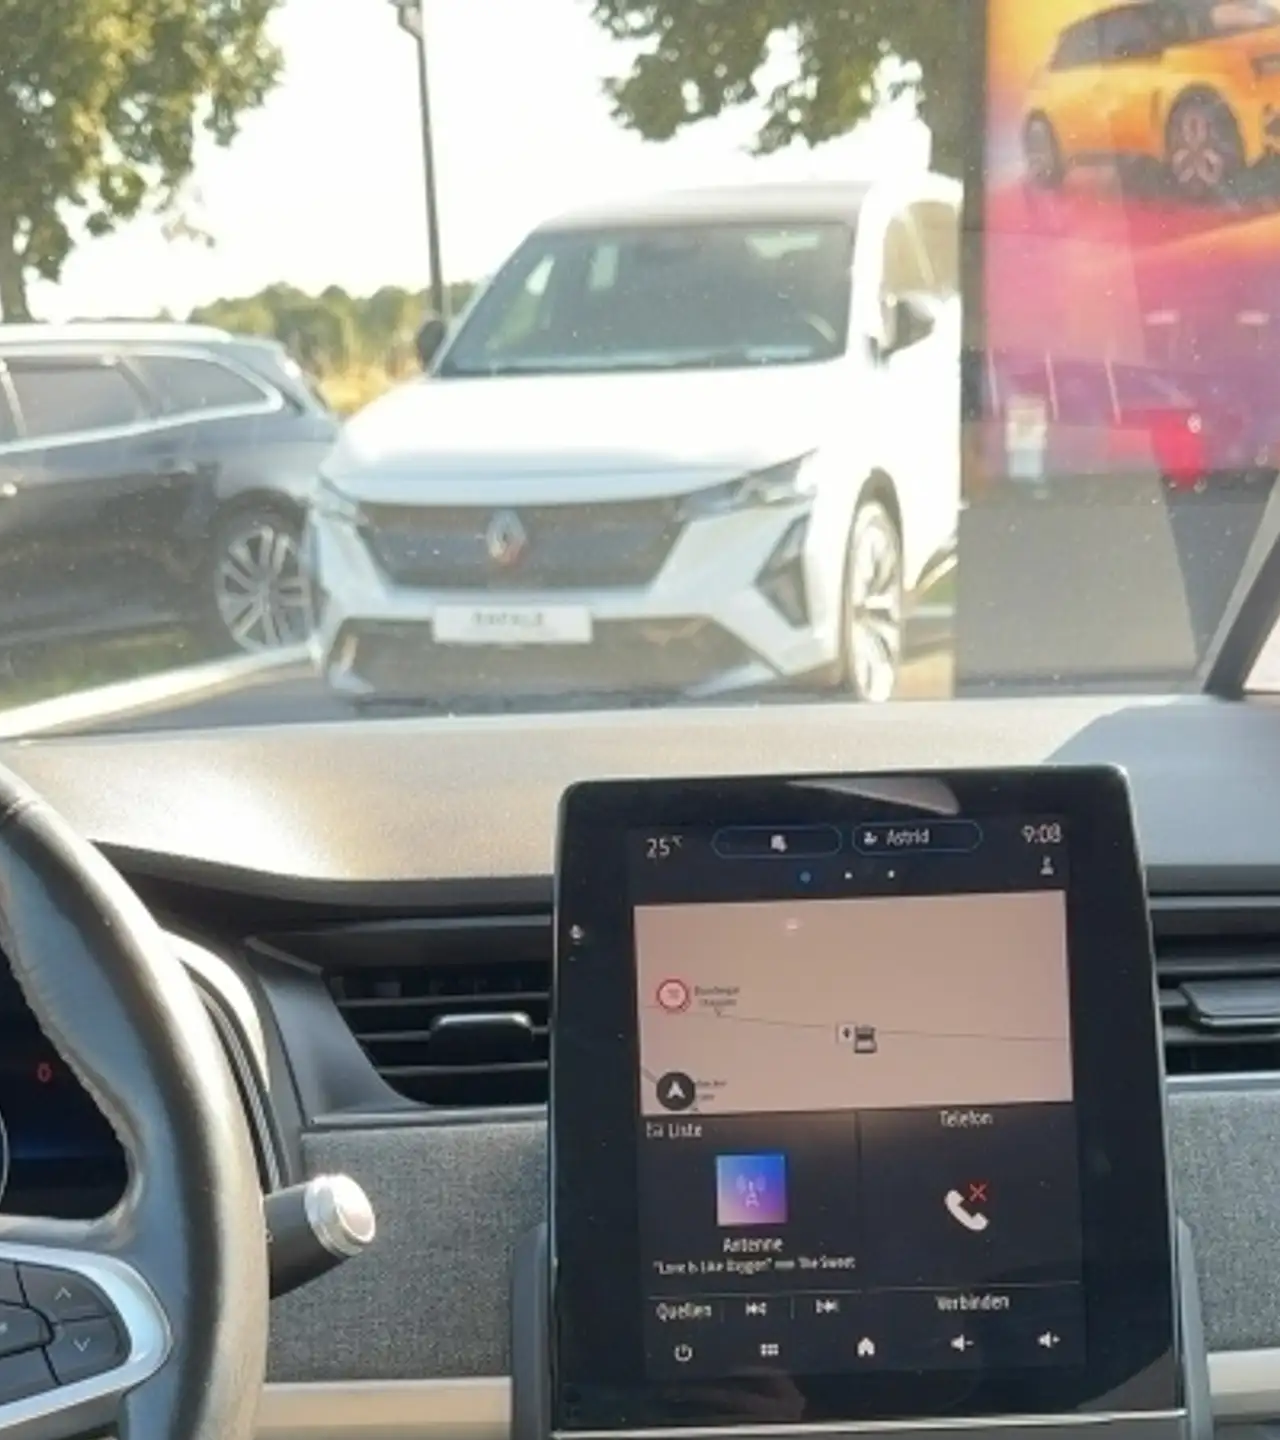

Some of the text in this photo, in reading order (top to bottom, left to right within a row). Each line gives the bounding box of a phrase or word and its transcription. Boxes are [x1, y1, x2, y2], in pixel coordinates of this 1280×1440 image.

[885, 828, 930, 846] Astrid
[939, 1110, 993, 1128] Telefon
[668, 1122, 703, 1140] Liste
[936, 1294, 1010, 1311] Verbinden
[656, 1303, 713, 1322] Quellen
